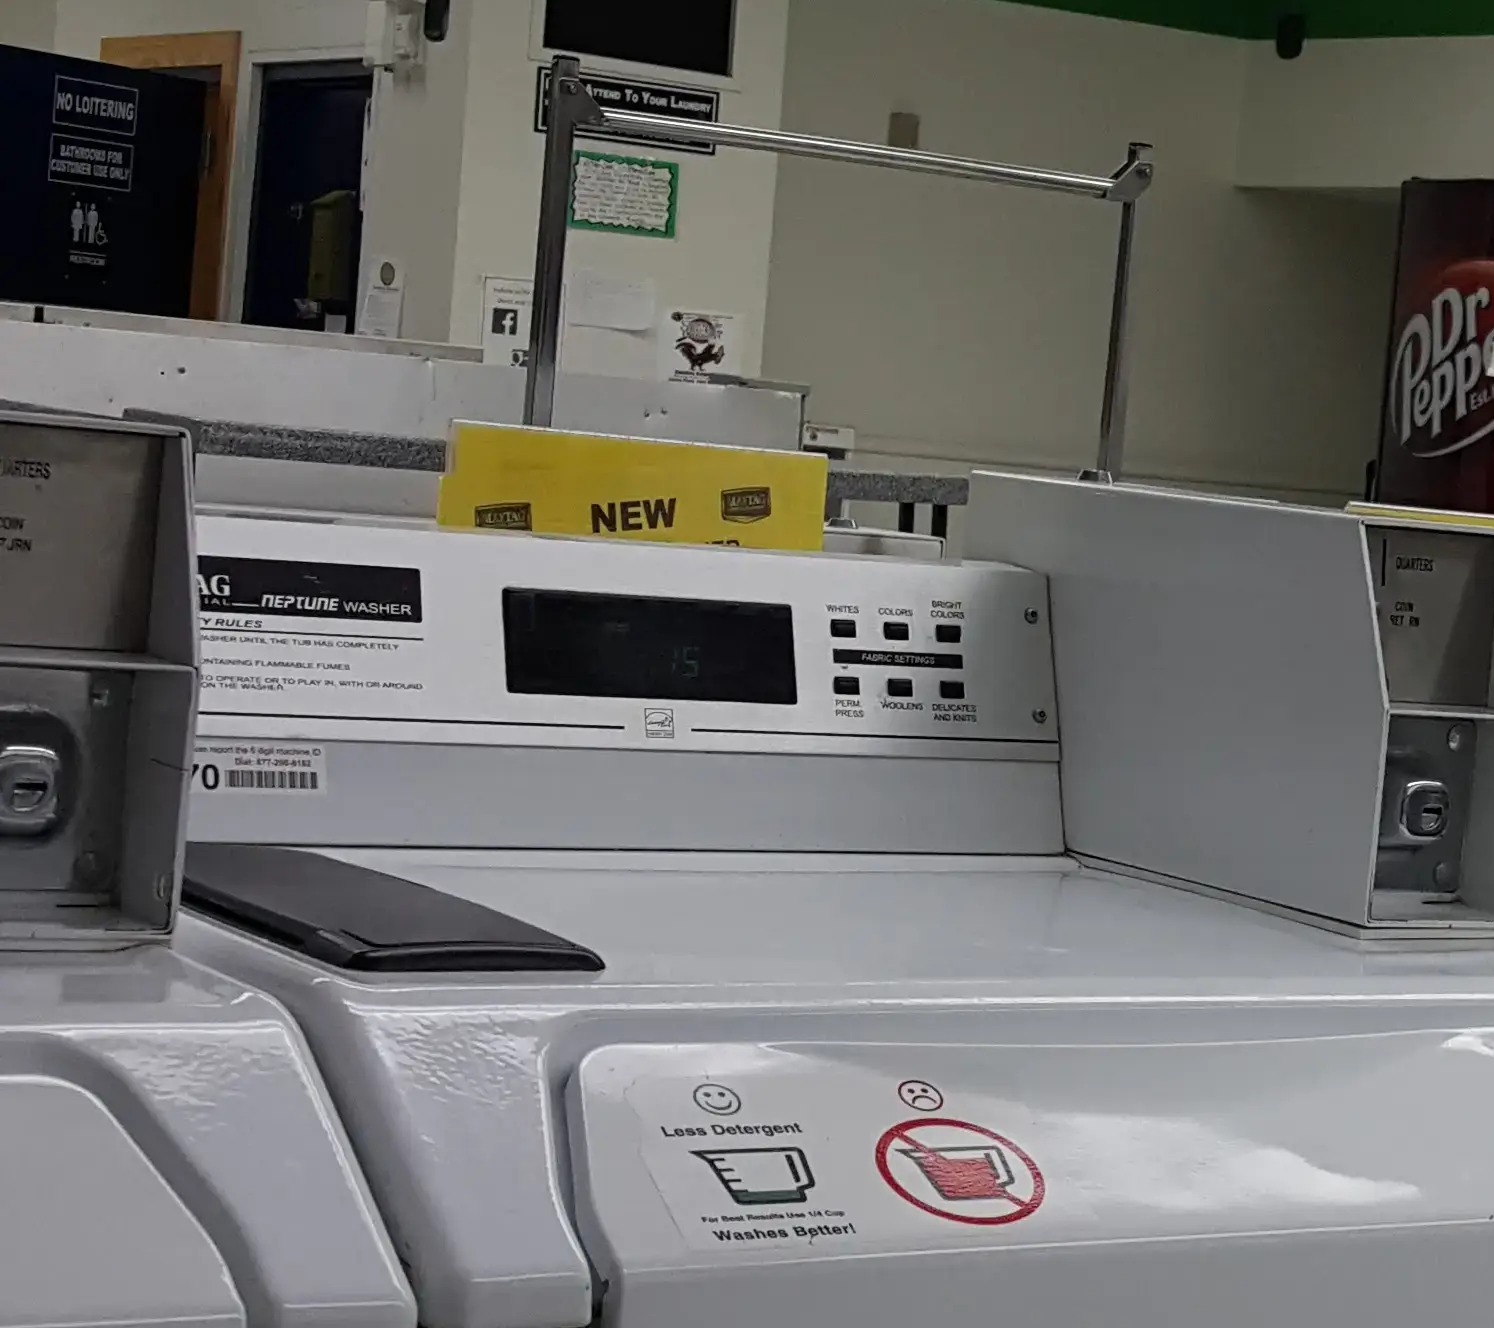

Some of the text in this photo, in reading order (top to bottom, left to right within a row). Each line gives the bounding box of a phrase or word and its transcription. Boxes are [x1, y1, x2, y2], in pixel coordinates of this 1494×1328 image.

[56, 92, 135, 120] NO LOITERING
[585, 84, 711, 113] ATTEND TO YOUR LAUNDRY
[60, 144, 123, 164] BATHROOMS FOR
[51, 159, 129, 180] CUSTOMER USE ONLY
[1432, 286, 1490, 366] Dr
[591, 497, 677, 534] NEW
[1396, 556, 1434, 572] QUARTERS
[261, 594, 339, 611] NEPTUNE
[343, 601, 412, 615] WASHER
[826, 604, 965, 620] WHITES COLORS COLORS
[931, 600, 962, 609] BRIGHT
[1395, 601, 1414, 612] COIN
[215, 618, 262, 628] RULES
[240, 636, 267, 645] UNTIL
[336, 641, 399, 650] COMPLETELY
[255, 660, 313, 669] FLAMMABLE
[862, 653, 935, 665] FABRIC SETTINGS
[216, 675, 259, 683] OPERATE
[382, 682, 423, 690] AROUND
[880, 701, 923, 711] WOOLENS
[932, 703, 976, 713] DELICATES
[836, 709, 977, 723] PRESS AND KNITS
[661, 1122, 803, 1137] Less Detergent
[826, 1210, 846, 1218] Cup
[712, 1222, 857, 1242] Washes Better!
